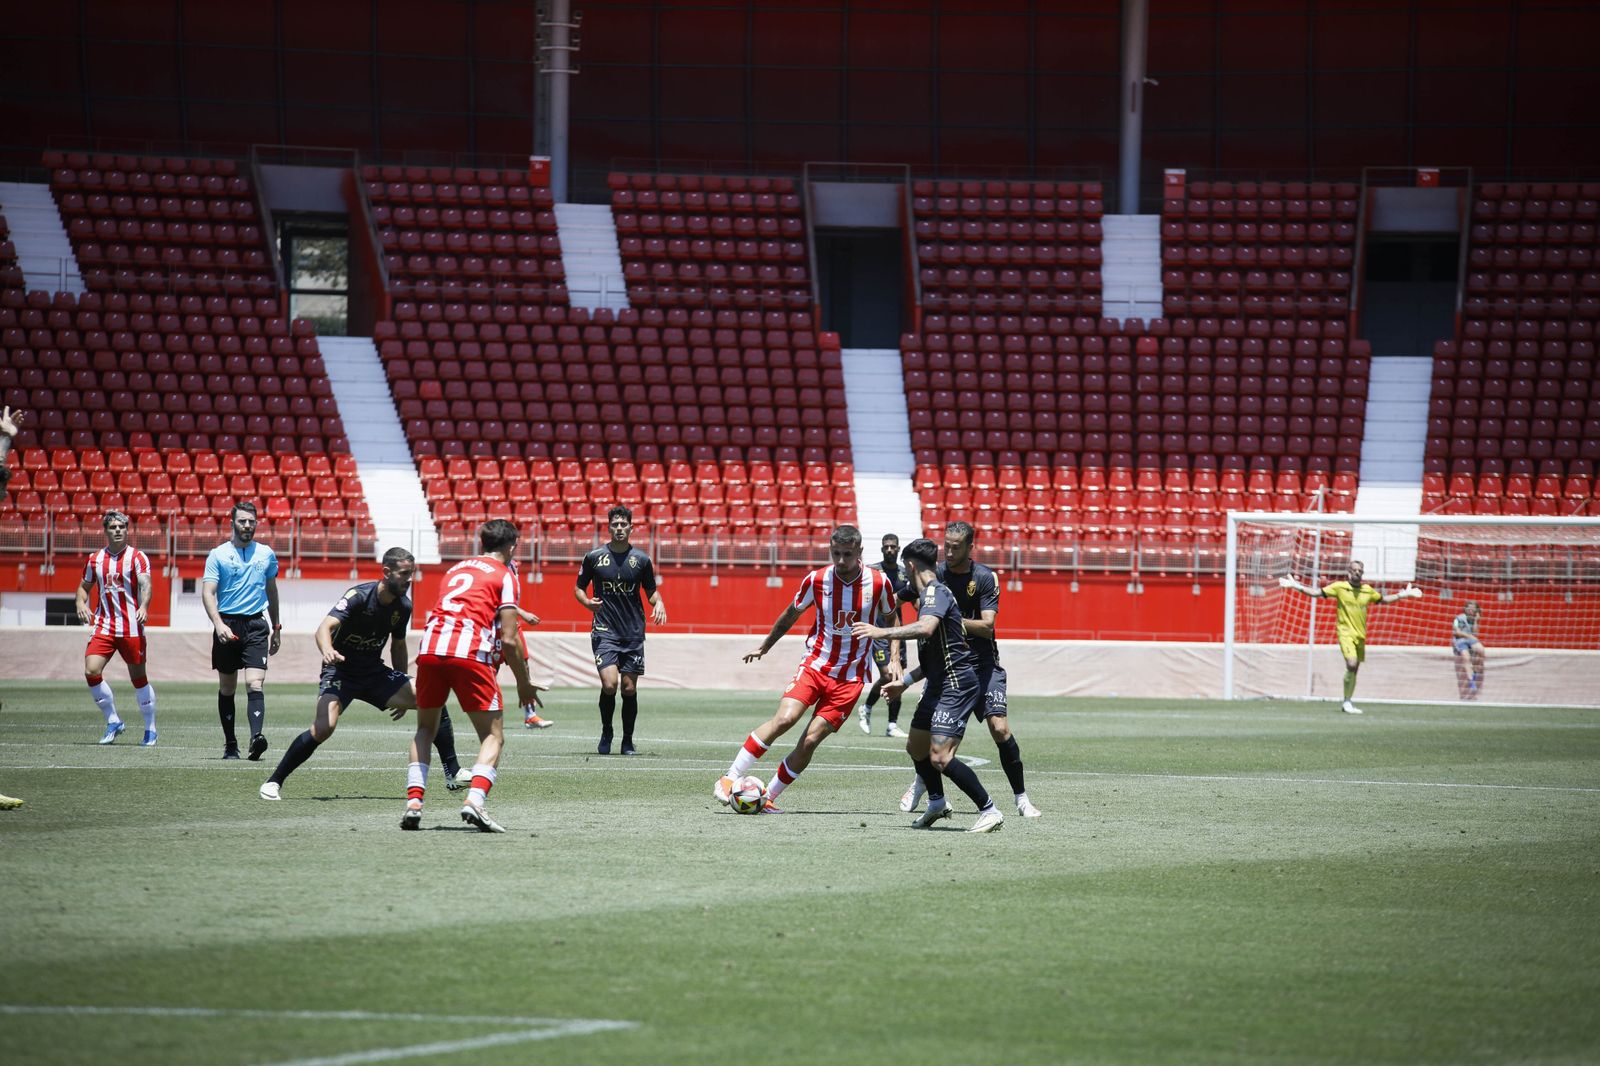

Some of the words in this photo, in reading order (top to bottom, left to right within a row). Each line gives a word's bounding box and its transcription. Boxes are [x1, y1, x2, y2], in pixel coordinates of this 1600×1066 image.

[597, 554, 611, 567] 16
[441, 572, 474, 613] 2
[601, 581, 637, 593] PKU
[834, 609, 858, 631] JK
